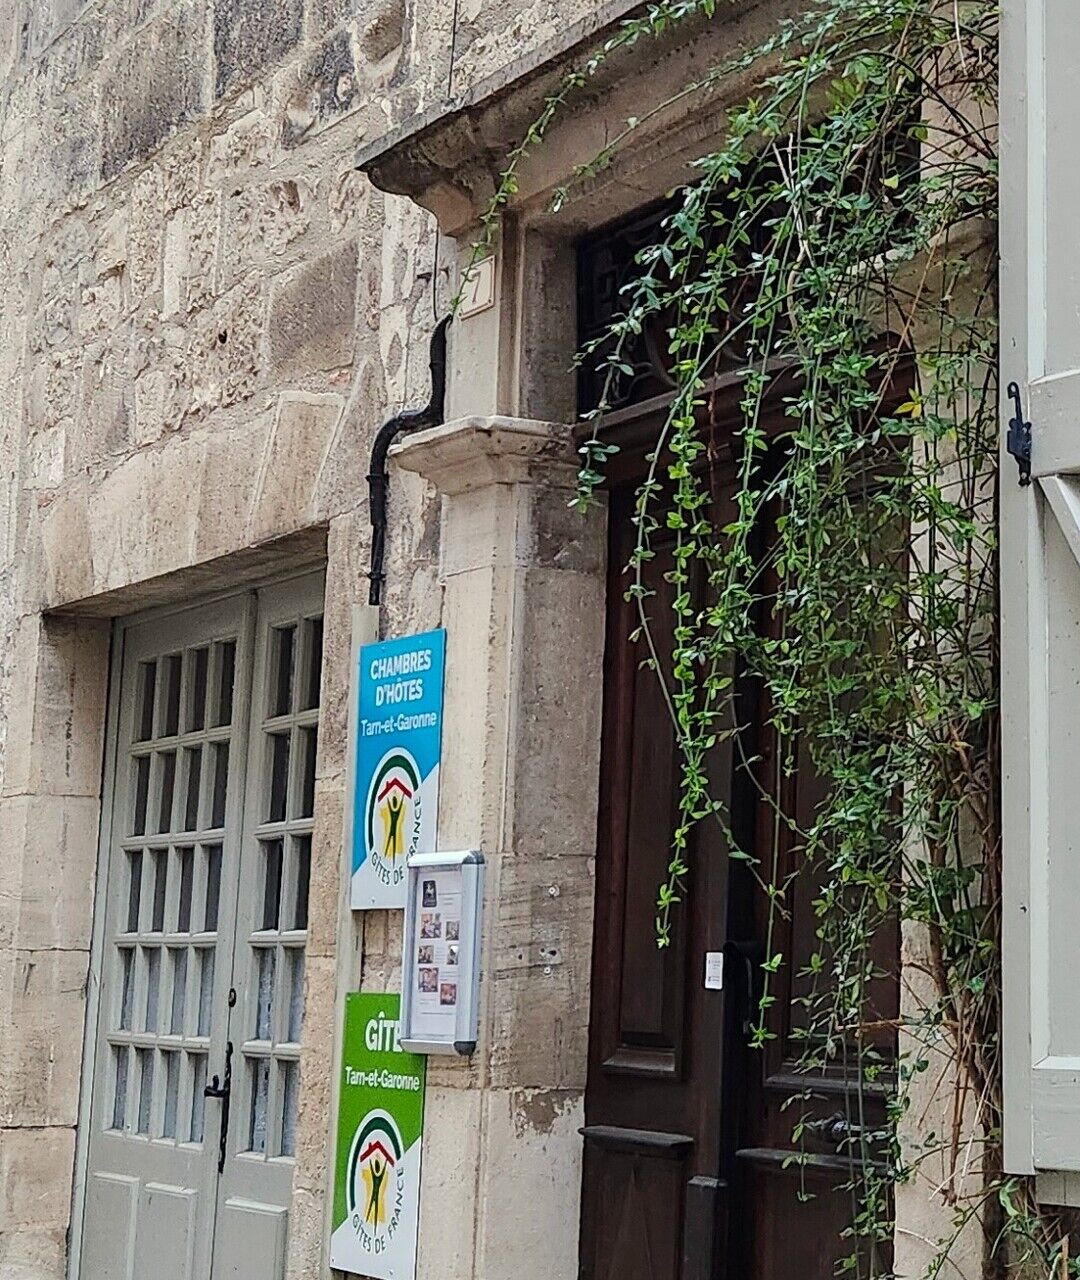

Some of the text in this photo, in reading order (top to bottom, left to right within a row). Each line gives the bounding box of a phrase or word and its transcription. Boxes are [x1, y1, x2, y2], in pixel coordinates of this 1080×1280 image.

[370, 649, 432, 680] CHAMBRES
[375, 677, 423, 707] D'HÔTES
[361, 712, 437, 736] Tarn-et-Garonne
[393, 865, 404, 885] DE
[345, 1065, 420, 1092] Tarn-et-Garonne
[374, 1234, 386, 1254] DE
[387, 1166, 404, 1240] FRANCE
